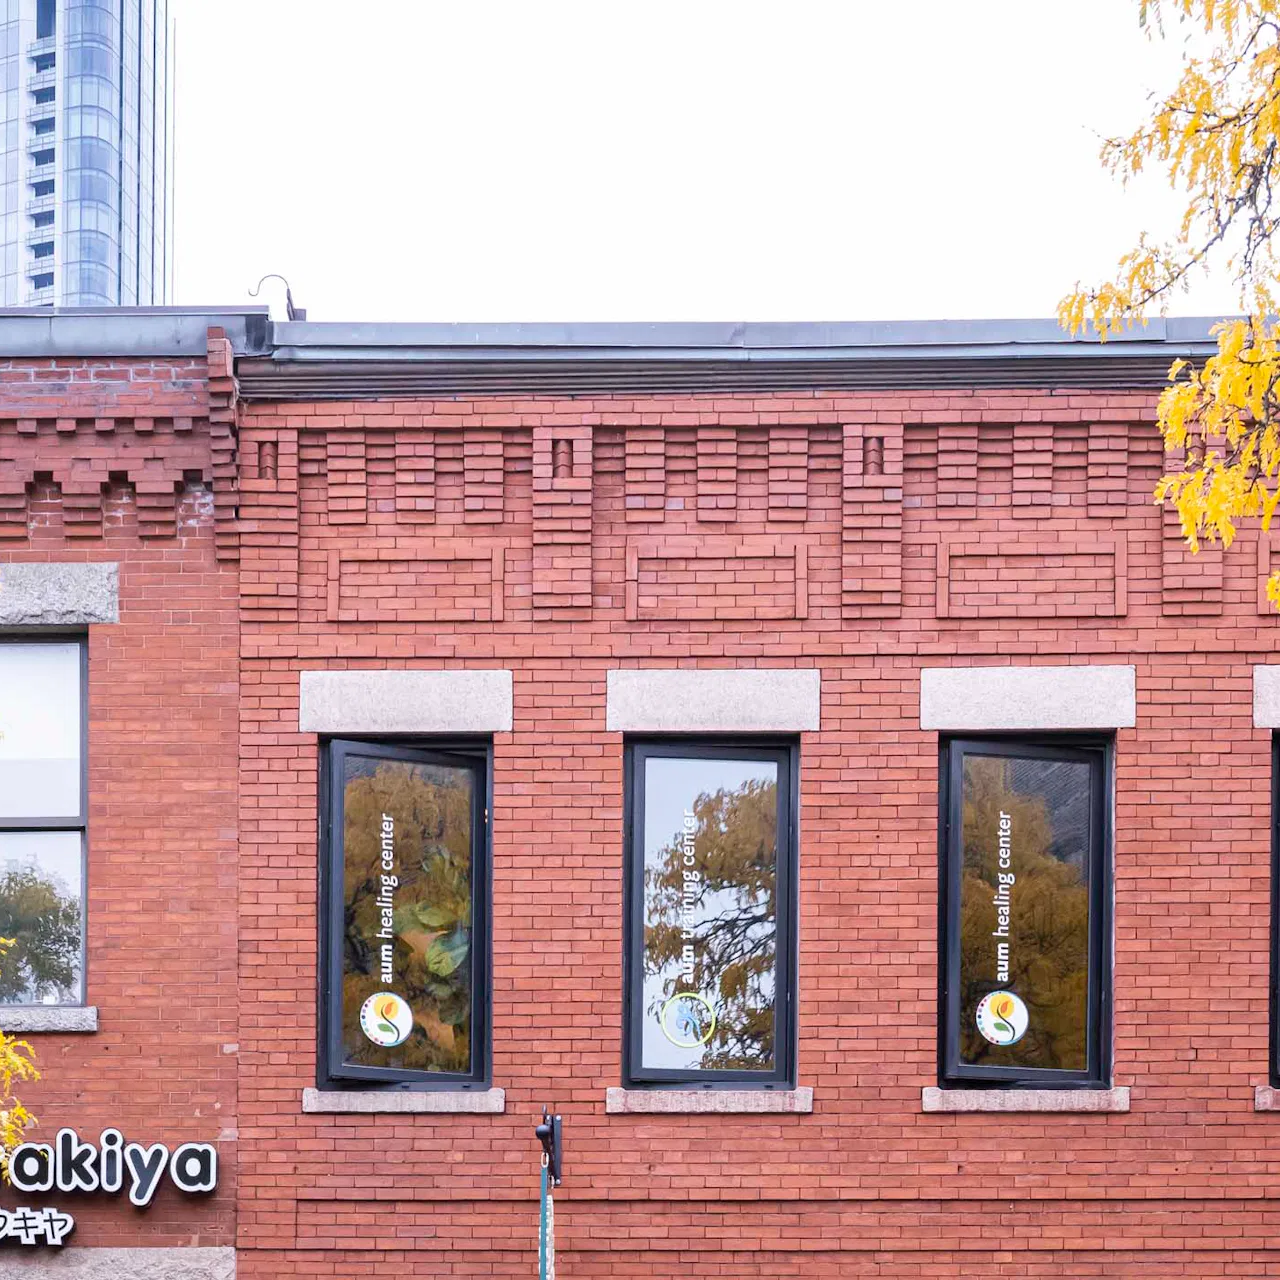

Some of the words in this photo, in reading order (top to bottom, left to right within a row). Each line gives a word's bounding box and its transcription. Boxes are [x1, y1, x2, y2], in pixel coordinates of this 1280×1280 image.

[381, 813, 394, 870] center
[682, 808, 696, 866] center
[998, 811, 1011, 868] center
[376, 875, 398, 938] healing
[681, 871, 701, 939] training
[992, 873, 1015, 937] healing
[381, 945, 393, 983] aum
[682, 945, 694, 984] aum
[997, 943, 1009, 981] aum
